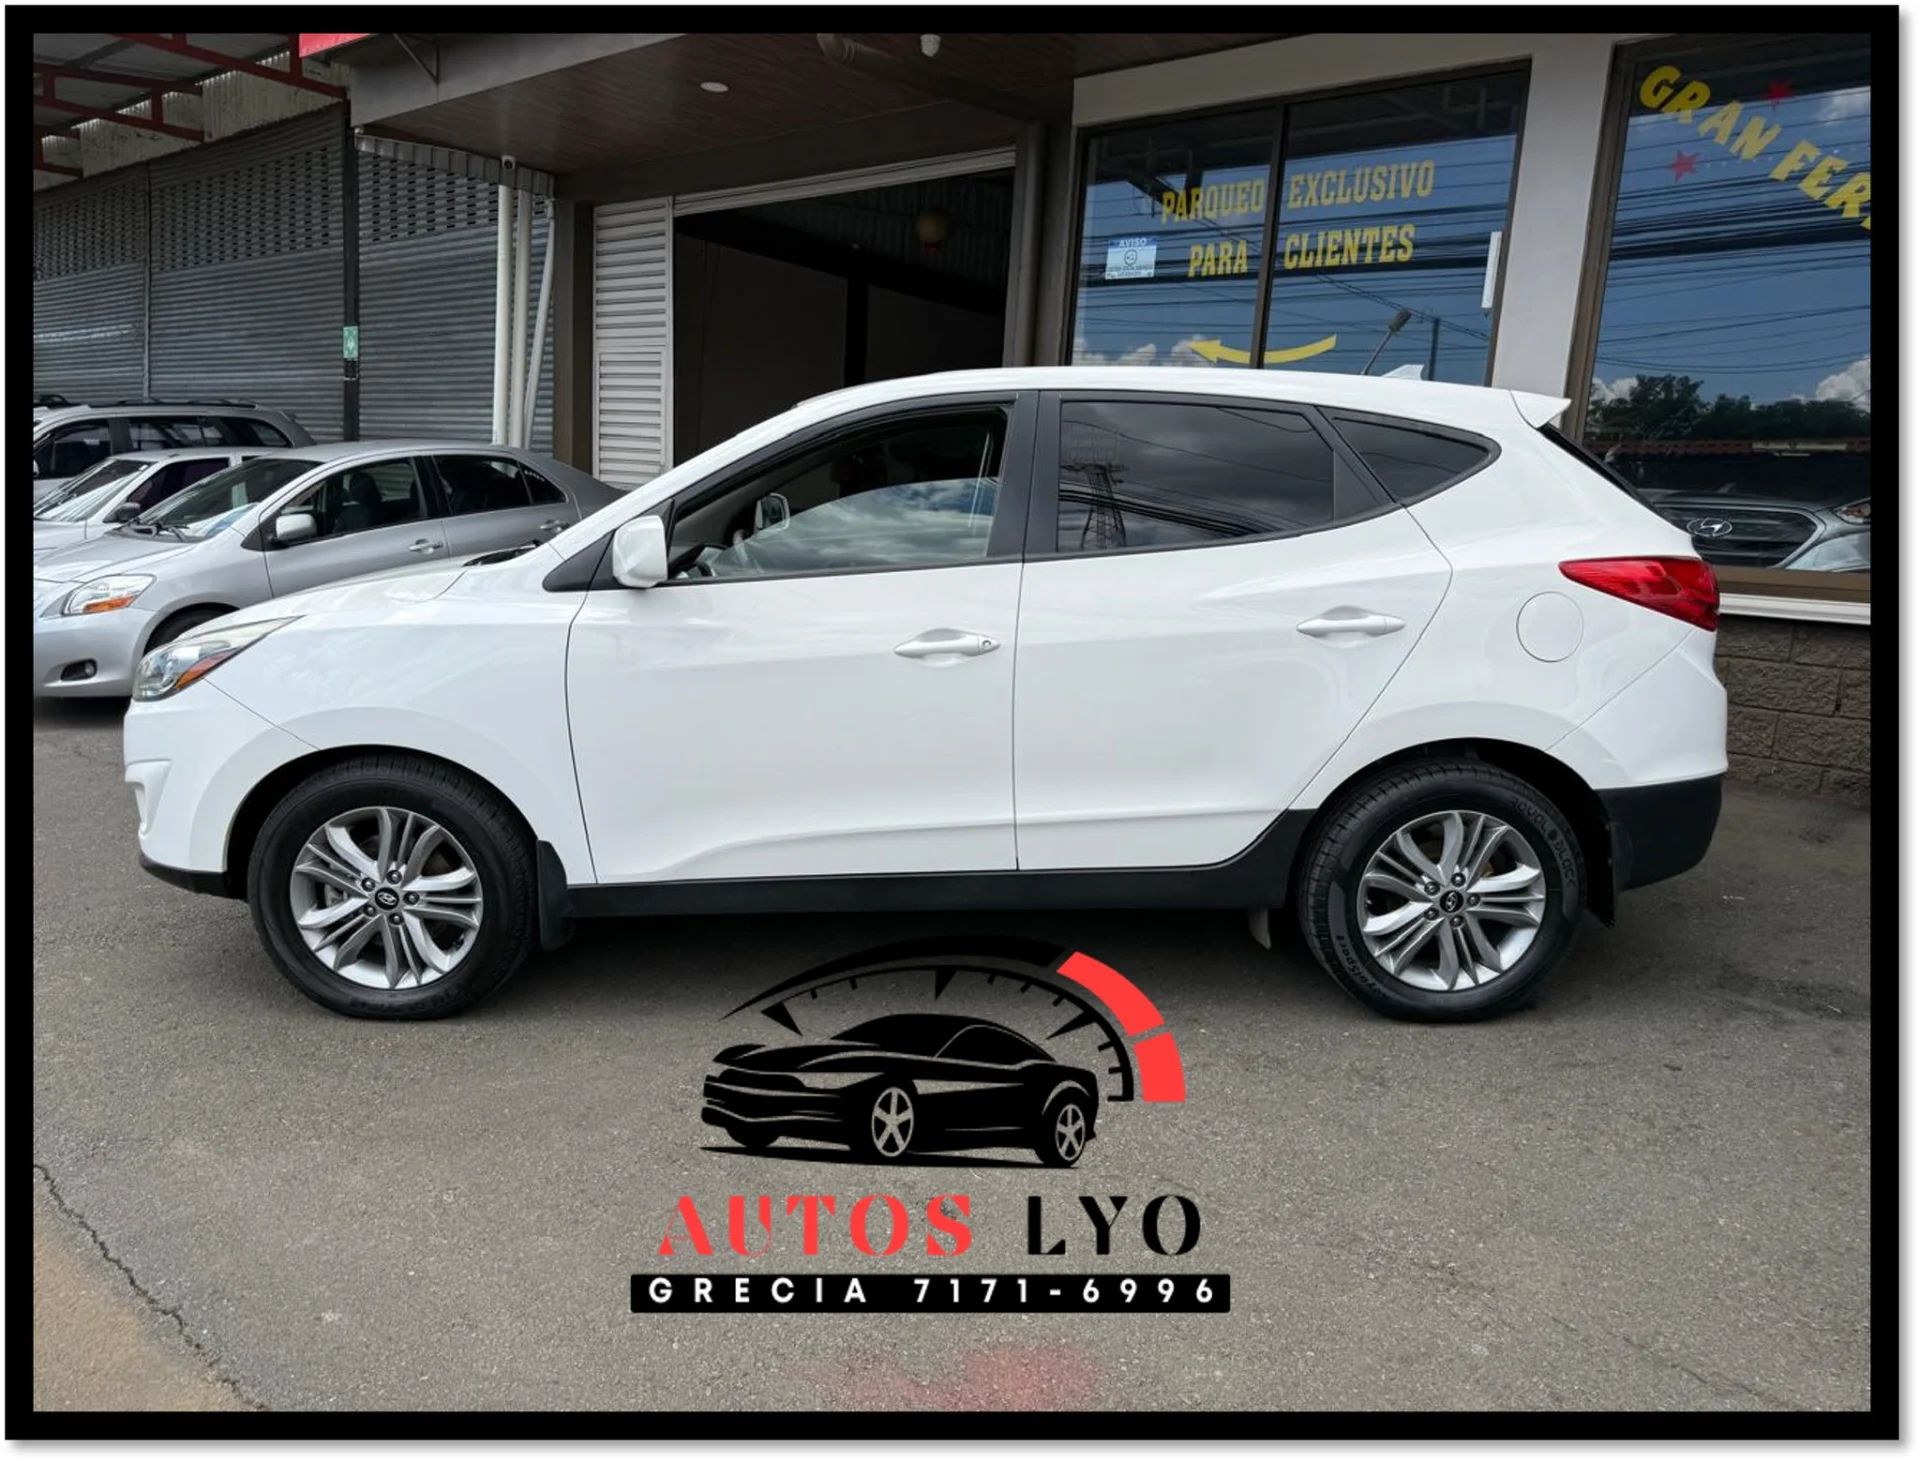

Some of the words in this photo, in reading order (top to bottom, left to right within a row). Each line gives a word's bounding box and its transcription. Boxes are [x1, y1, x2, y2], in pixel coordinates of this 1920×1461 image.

[1639, 65, 1782, 161] GRAN
[1767, 139, 1871, 231] FER
[1161, 178, 1265, 224] PARQUEO
[1288, 160, 1435, 209] EXCLUSIVO
[1119, 238, 1148, 248] AVISO
[1188, 239, 1248, 278] PARA
[1284, 224, 1416, 271] CLIENTES
